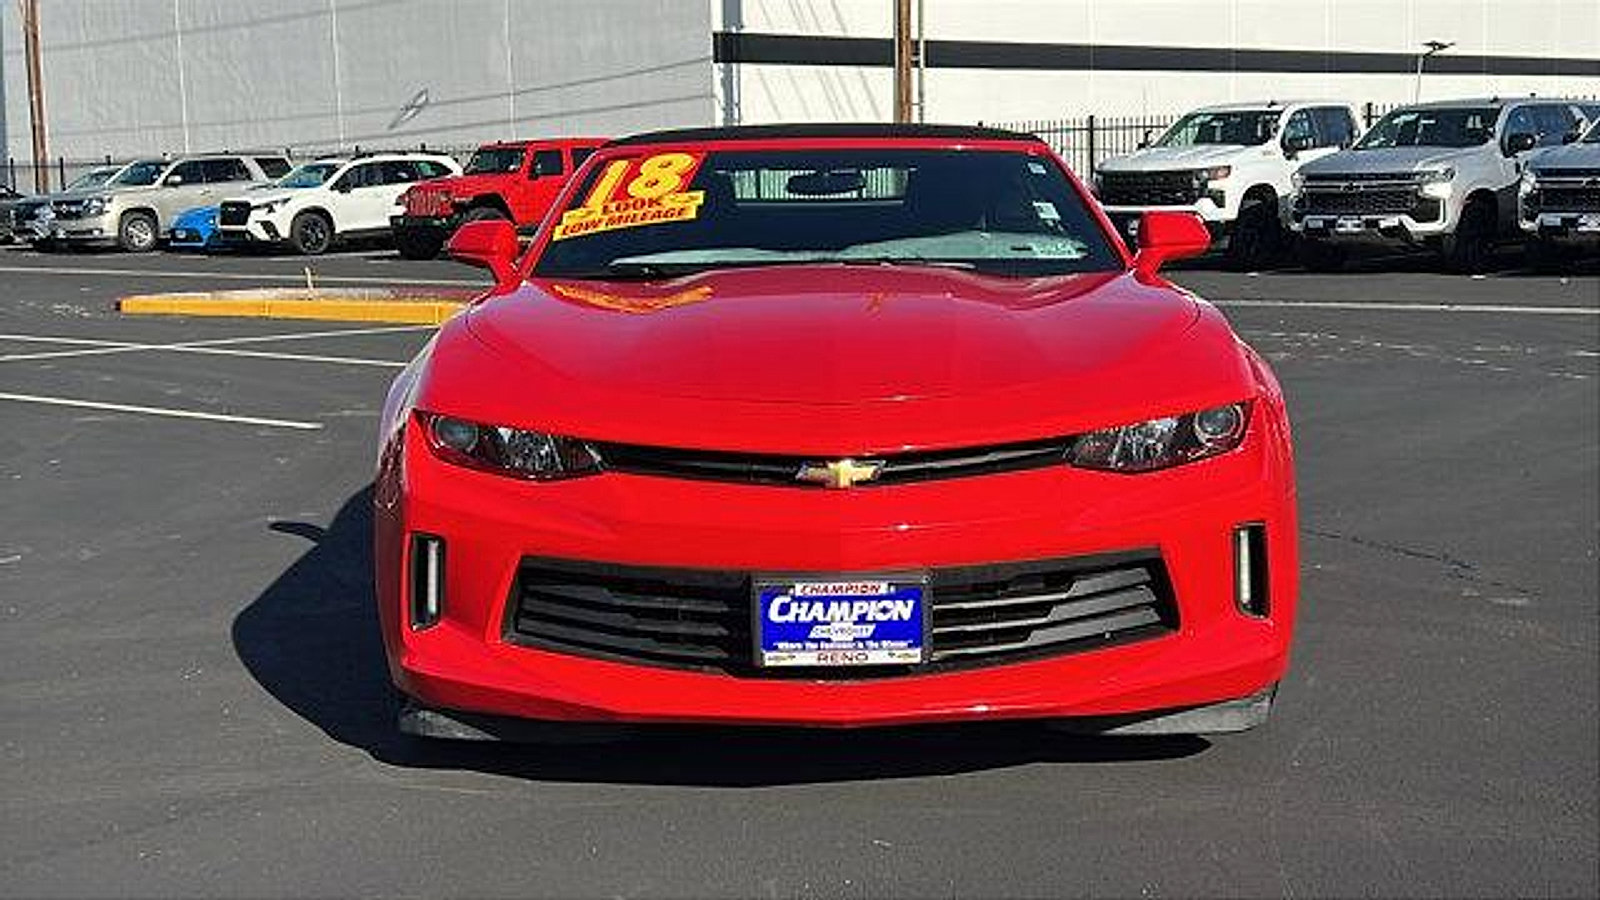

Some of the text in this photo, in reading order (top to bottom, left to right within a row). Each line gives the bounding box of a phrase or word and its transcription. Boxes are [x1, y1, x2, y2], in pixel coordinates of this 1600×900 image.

[586, 153, 696, 208] 18
[602, 198, 662, 214] LOOK
[562, 207, 685, 236] LOW MILEAGE
[799, 584, 881, 594] CHAMPION
[768, 596, 914, 623] CHAMPION
[817, 652, 869, 661] RENO
